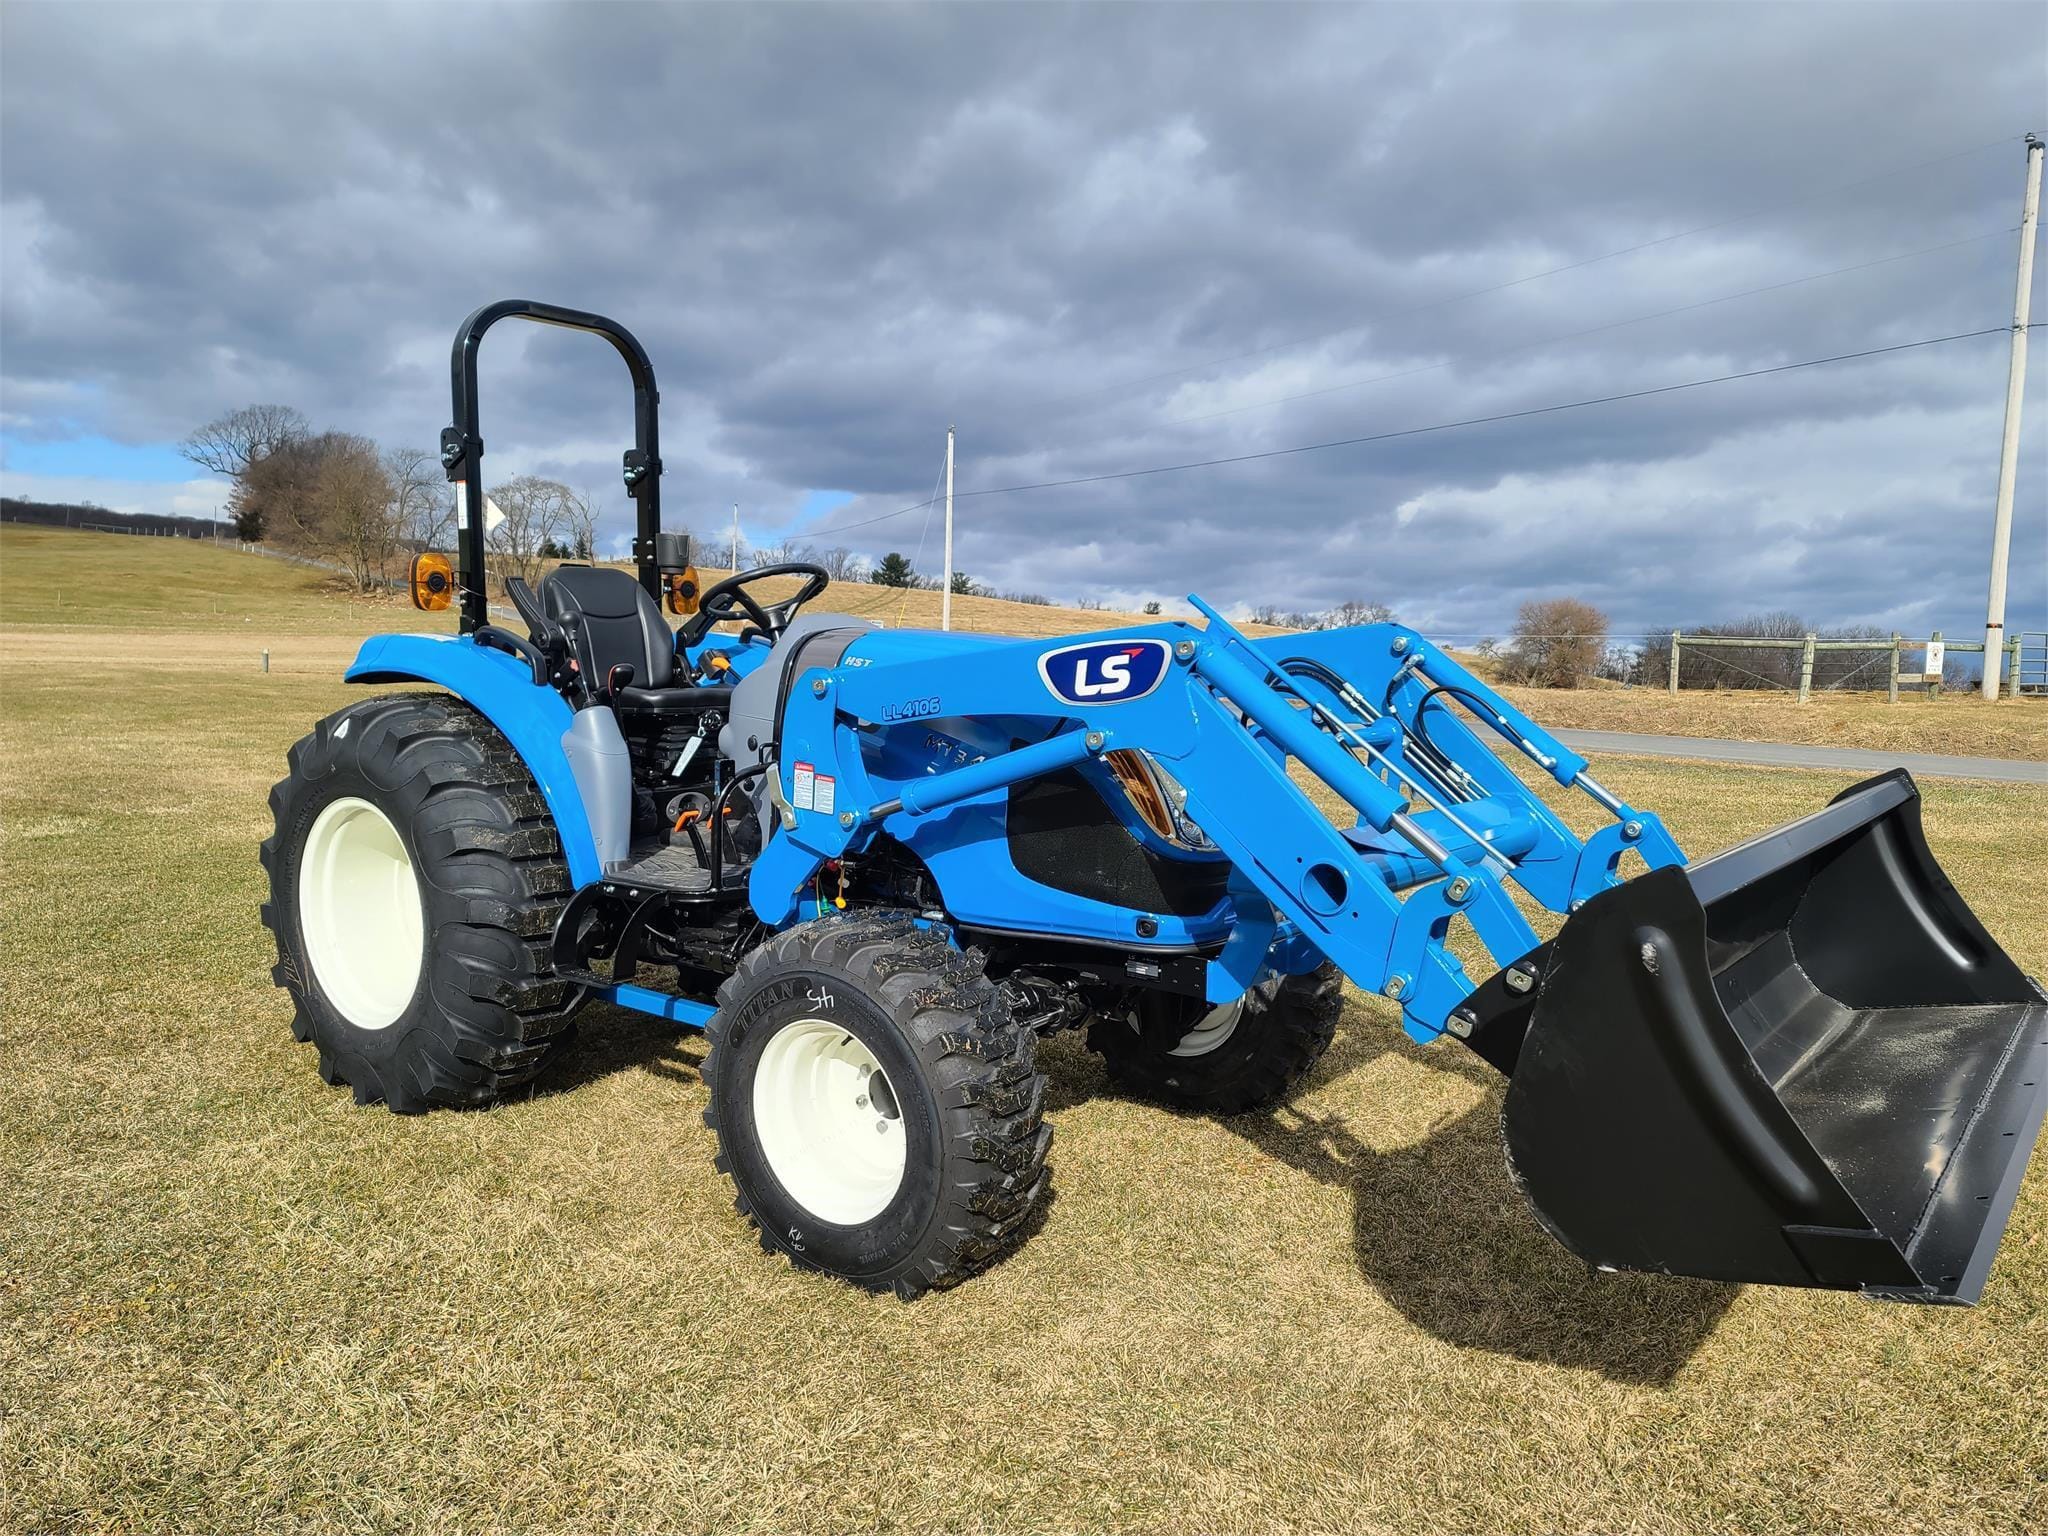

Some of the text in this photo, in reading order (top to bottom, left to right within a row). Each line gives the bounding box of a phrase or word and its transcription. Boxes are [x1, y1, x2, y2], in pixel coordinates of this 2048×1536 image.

[844, 656, 873, 667] HST
[1075, 654, 1131, 697] LS
[881, 697, 942, 721] LL4106
[736, 980, 795, 1033] TITAN
